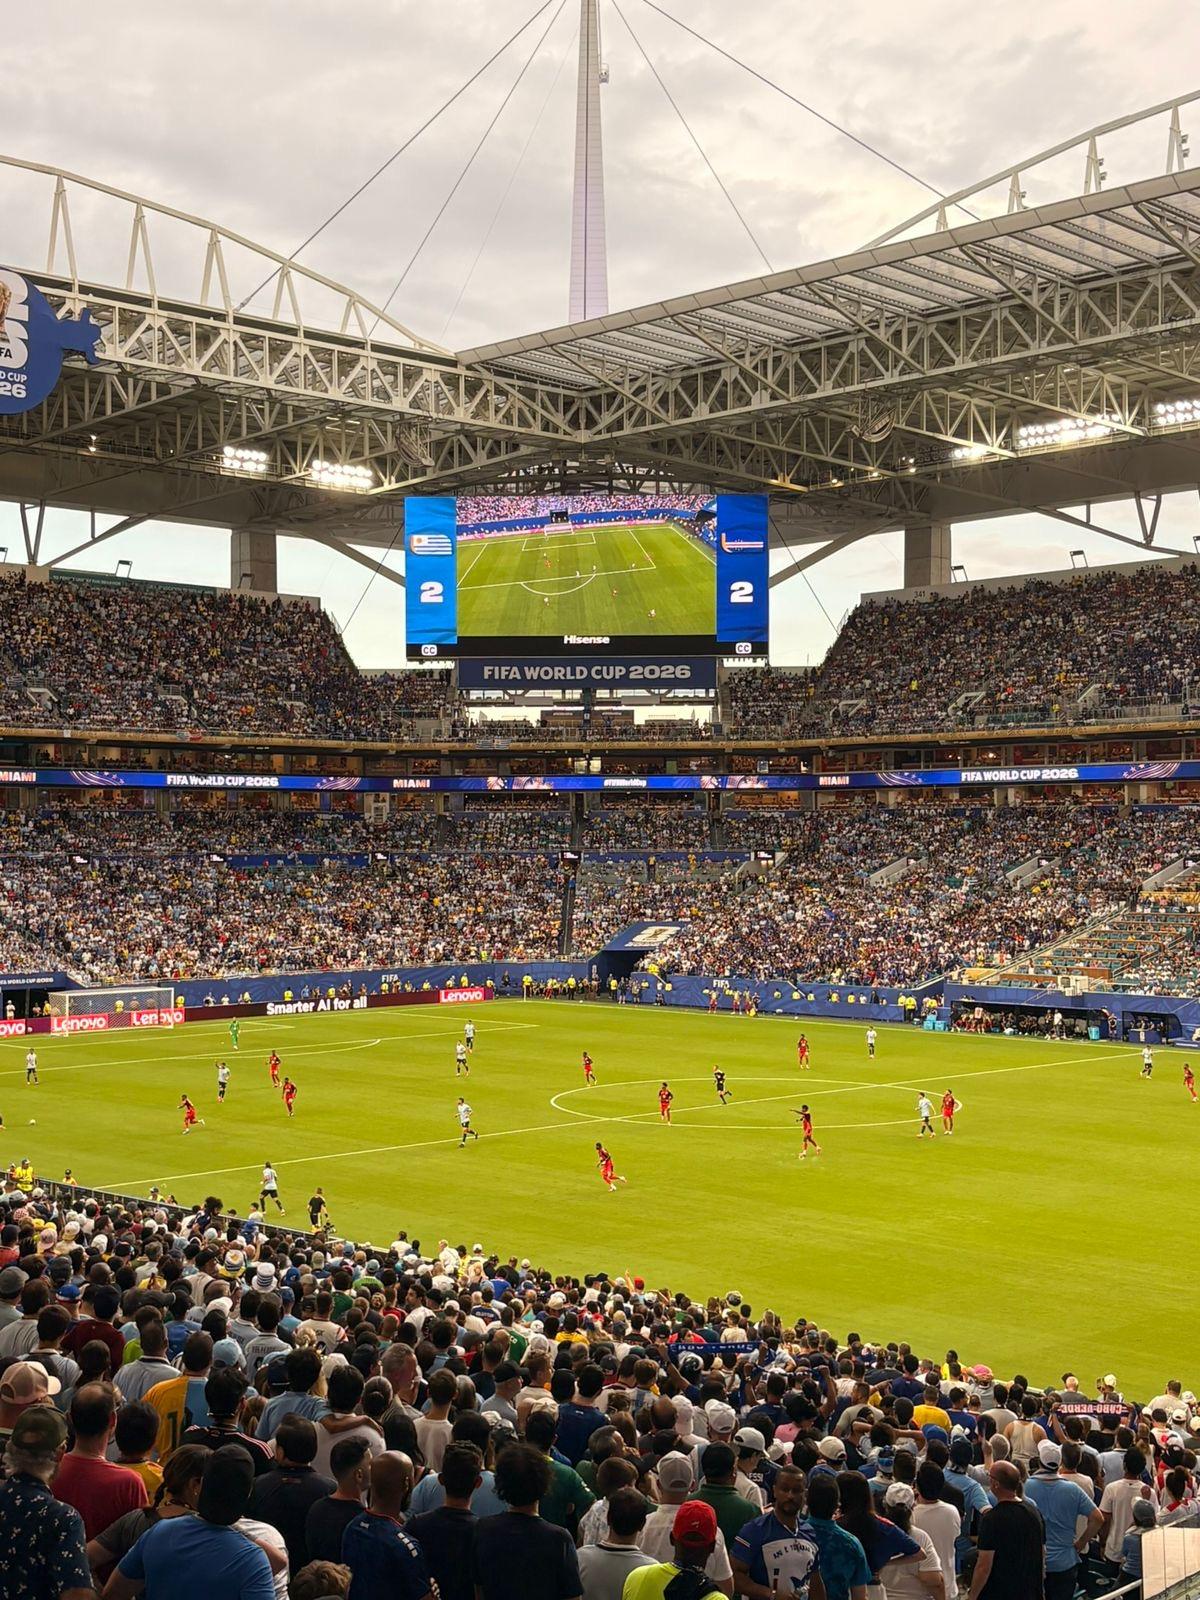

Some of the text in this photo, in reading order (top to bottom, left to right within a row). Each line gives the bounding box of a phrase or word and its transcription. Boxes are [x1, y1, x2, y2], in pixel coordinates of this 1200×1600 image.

[7, 372, 27, 382] CUP
[421, 582, 443, 602] 2
[731, 582, 753, 602] 2
[564, 635, 610, 644] Hisense
[423, 647, 436, 655] CC
[738, 644, 750, 652] CC
[484, 665, 691, 680] FIFA WORLD CUP 2026
[819, 776, 849, 785] MIAMI
[961, 768, 1078, 781] FIFA WORLD CUP 2026
[166, 775, 279, 787] FIFA WORLD CUP 2026
[393, 779, 430, 788] MIAMI
[713, 979, 730, 988] FIFA
[441, 989, 483, 1003] Lenovo
[266, 1002, 315, 1016] Smarter
[333, 999, 351, 1011] for
[353, 996, 368, 1009] all
[53, 1015, 107, 1032] Lenovo
[133, 1011, 183, 1026] Lenovo
[1060, 1403, 1122, 1415] CABO VERDE
